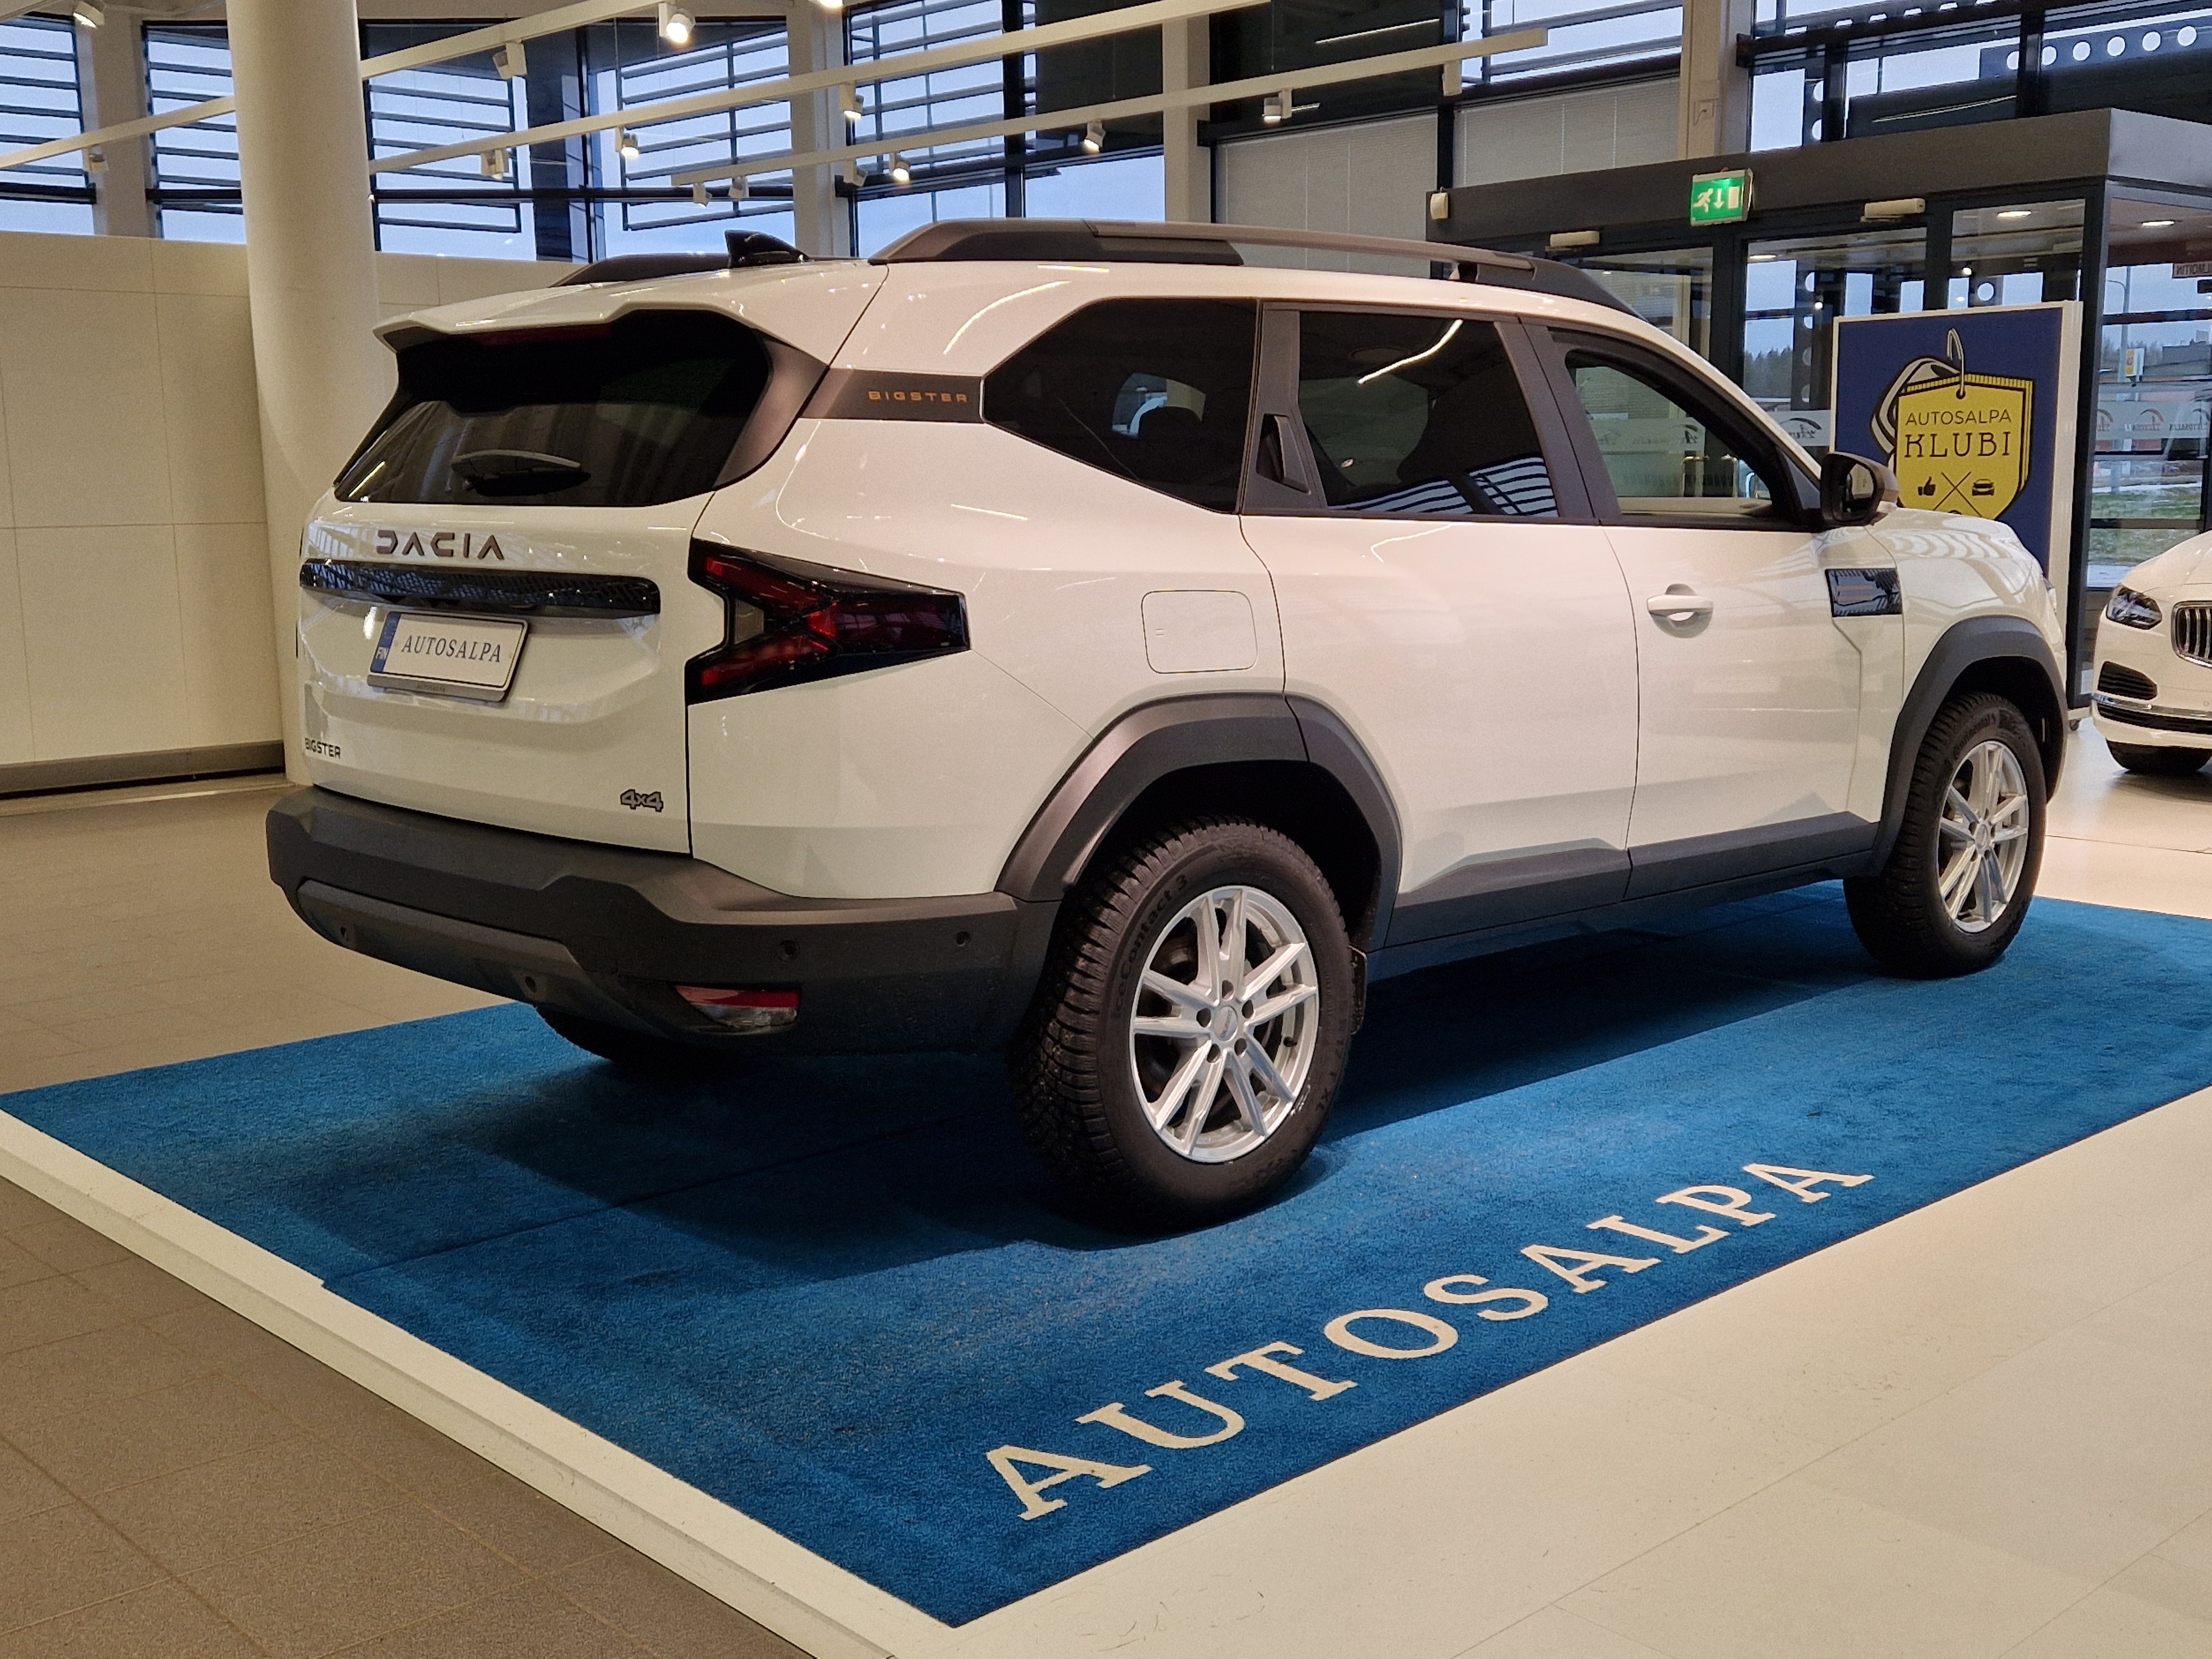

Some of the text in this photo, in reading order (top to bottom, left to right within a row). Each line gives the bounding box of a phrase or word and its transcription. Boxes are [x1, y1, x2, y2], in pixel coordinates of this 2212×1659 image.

[868, 390, 968, 403] BIGSTER
[1906, 409, 2011, 426] AUTOSALPA
[1904, 431, 2011, 458] KLUBI
[376, 530, 505, 560] DACIA
[376, 647, 389, 660] FIN
[401, 635, 501, 663] AUTOSALPA
[305, 737, 341, 759] BIGSTER
[620, 789, 664, 812] 4x4
[1176, 874, 1188, 891] 3
[985, 1162, 1874, 1521] AUTOSALPA
